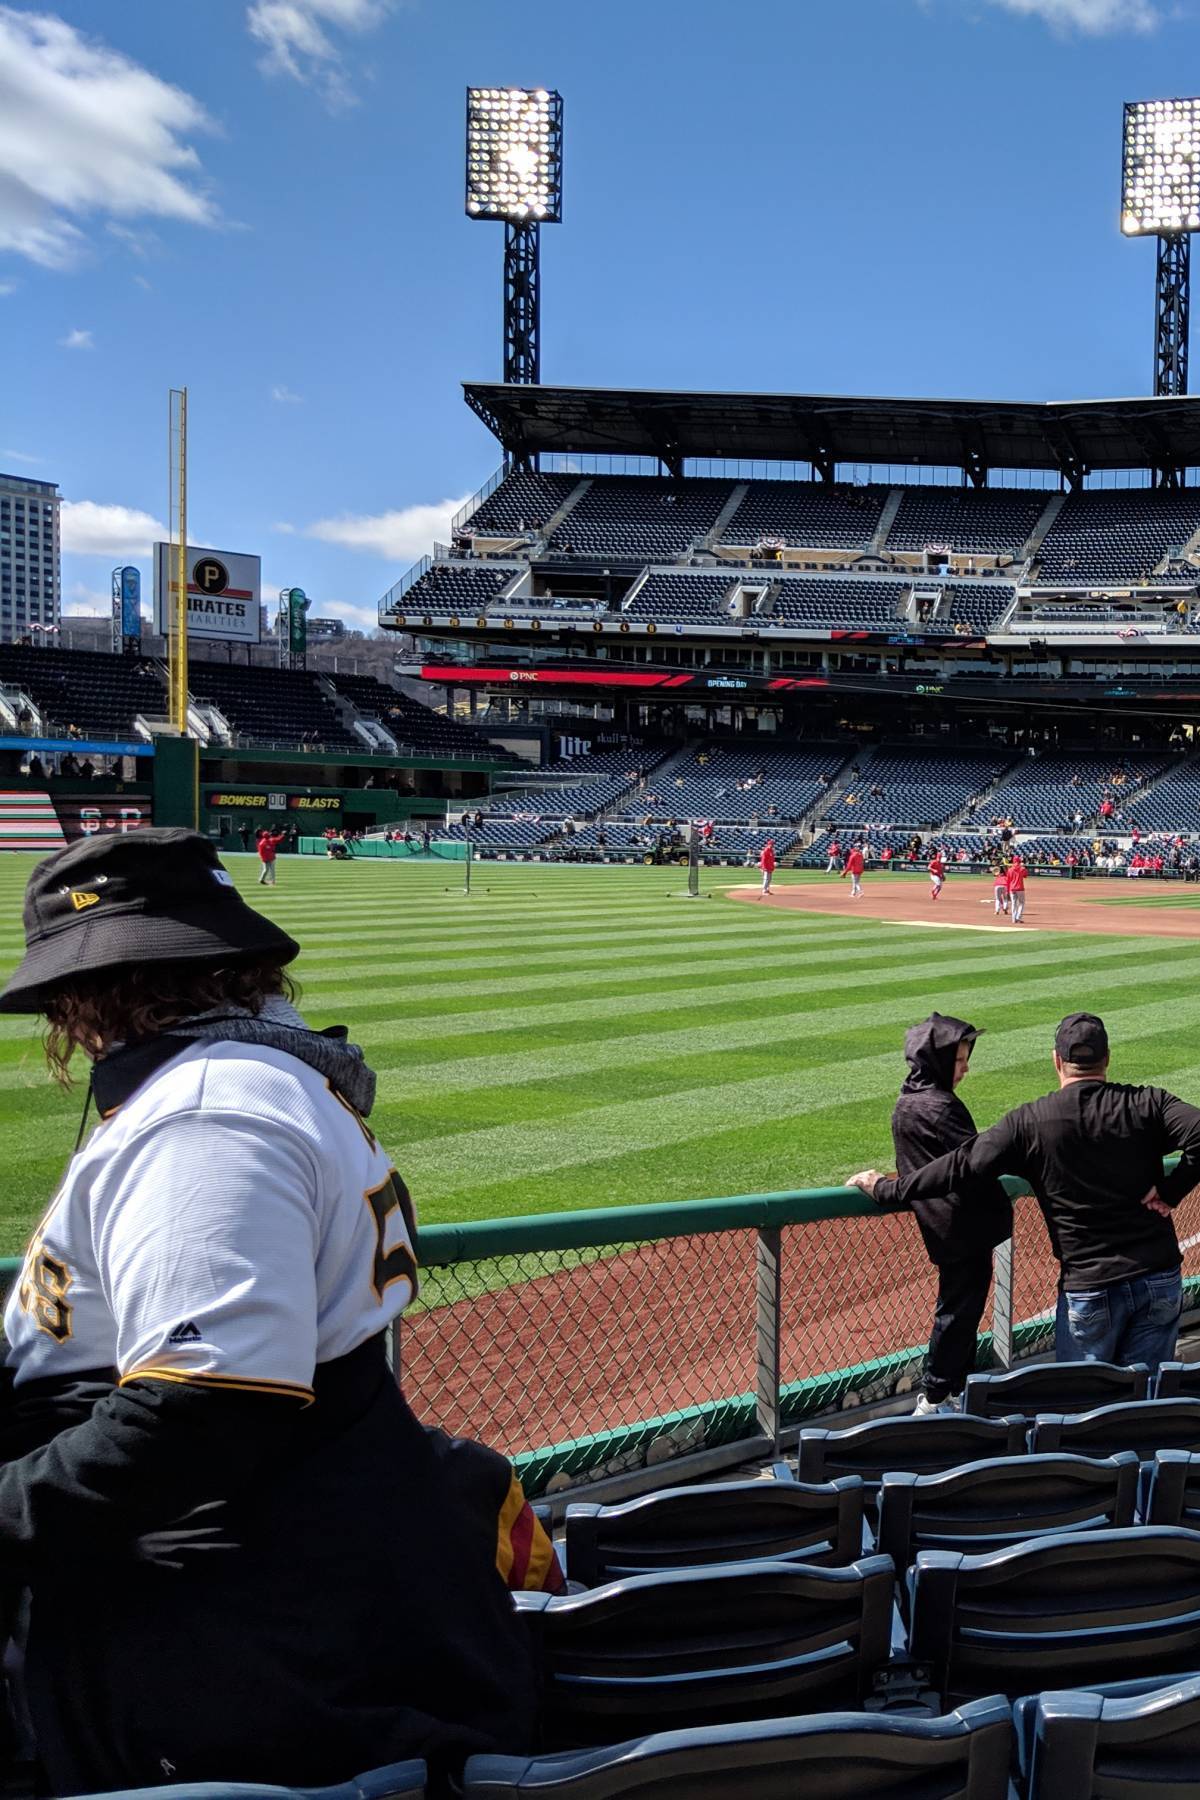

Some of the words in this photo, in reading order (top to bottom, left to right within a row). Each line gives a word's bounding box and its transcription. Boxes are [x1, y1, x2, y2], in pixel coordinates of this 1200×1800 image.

[203, 565, 220, 588] P
[519, 672, 539, 681] PNC
[707, 680, 735, 688] OPENING
[560, 735, 592, 760] Lite
[218, 794, 267, 806] BOWSER
[298, 797, 340, 809] BLASTS
